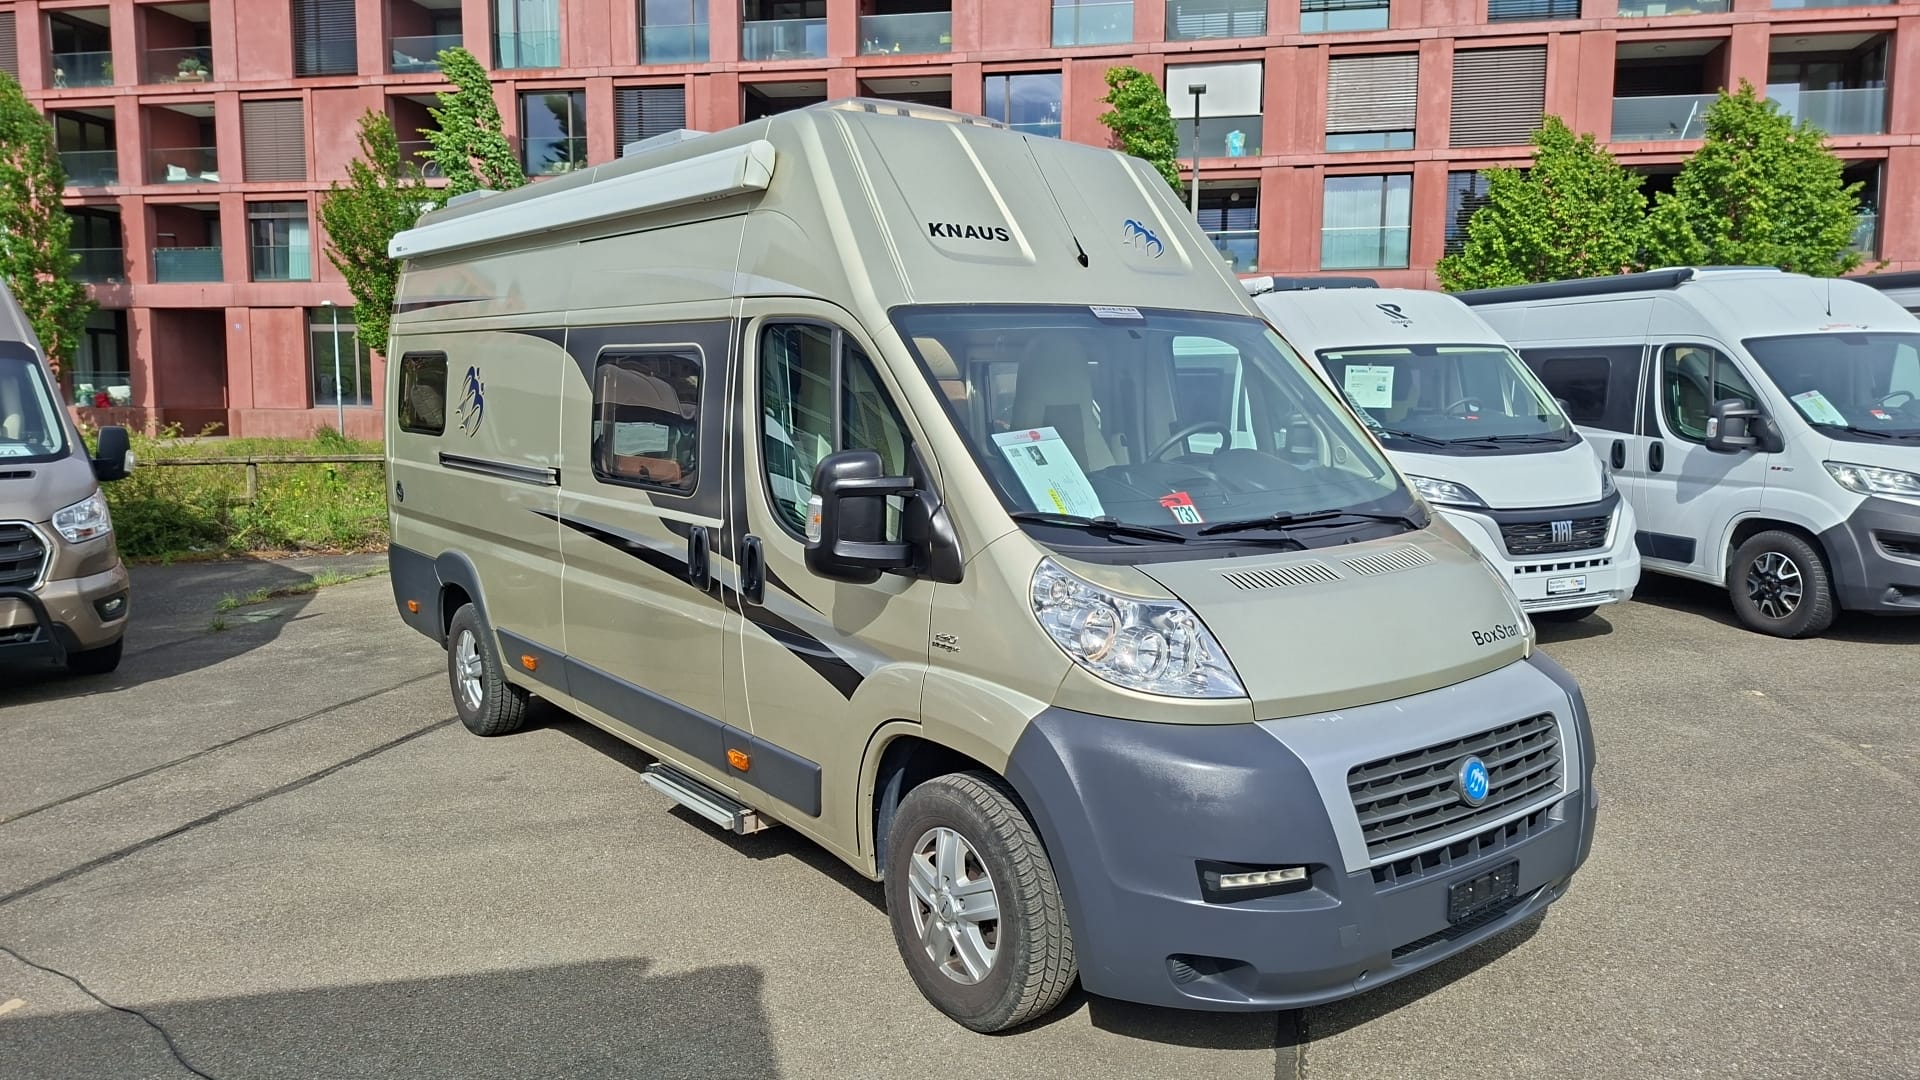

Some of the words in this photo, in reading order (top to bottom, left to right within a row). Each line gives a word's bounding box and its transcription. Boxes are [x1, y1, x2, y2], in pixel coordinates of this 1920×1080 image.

[928, 222, 1010, 242] KNAUS
[1172, 506, 1200, 523] 731
[1551, 520, 1573, 543] FIAT
[1471, 623, 1519, 646] BoxStar
